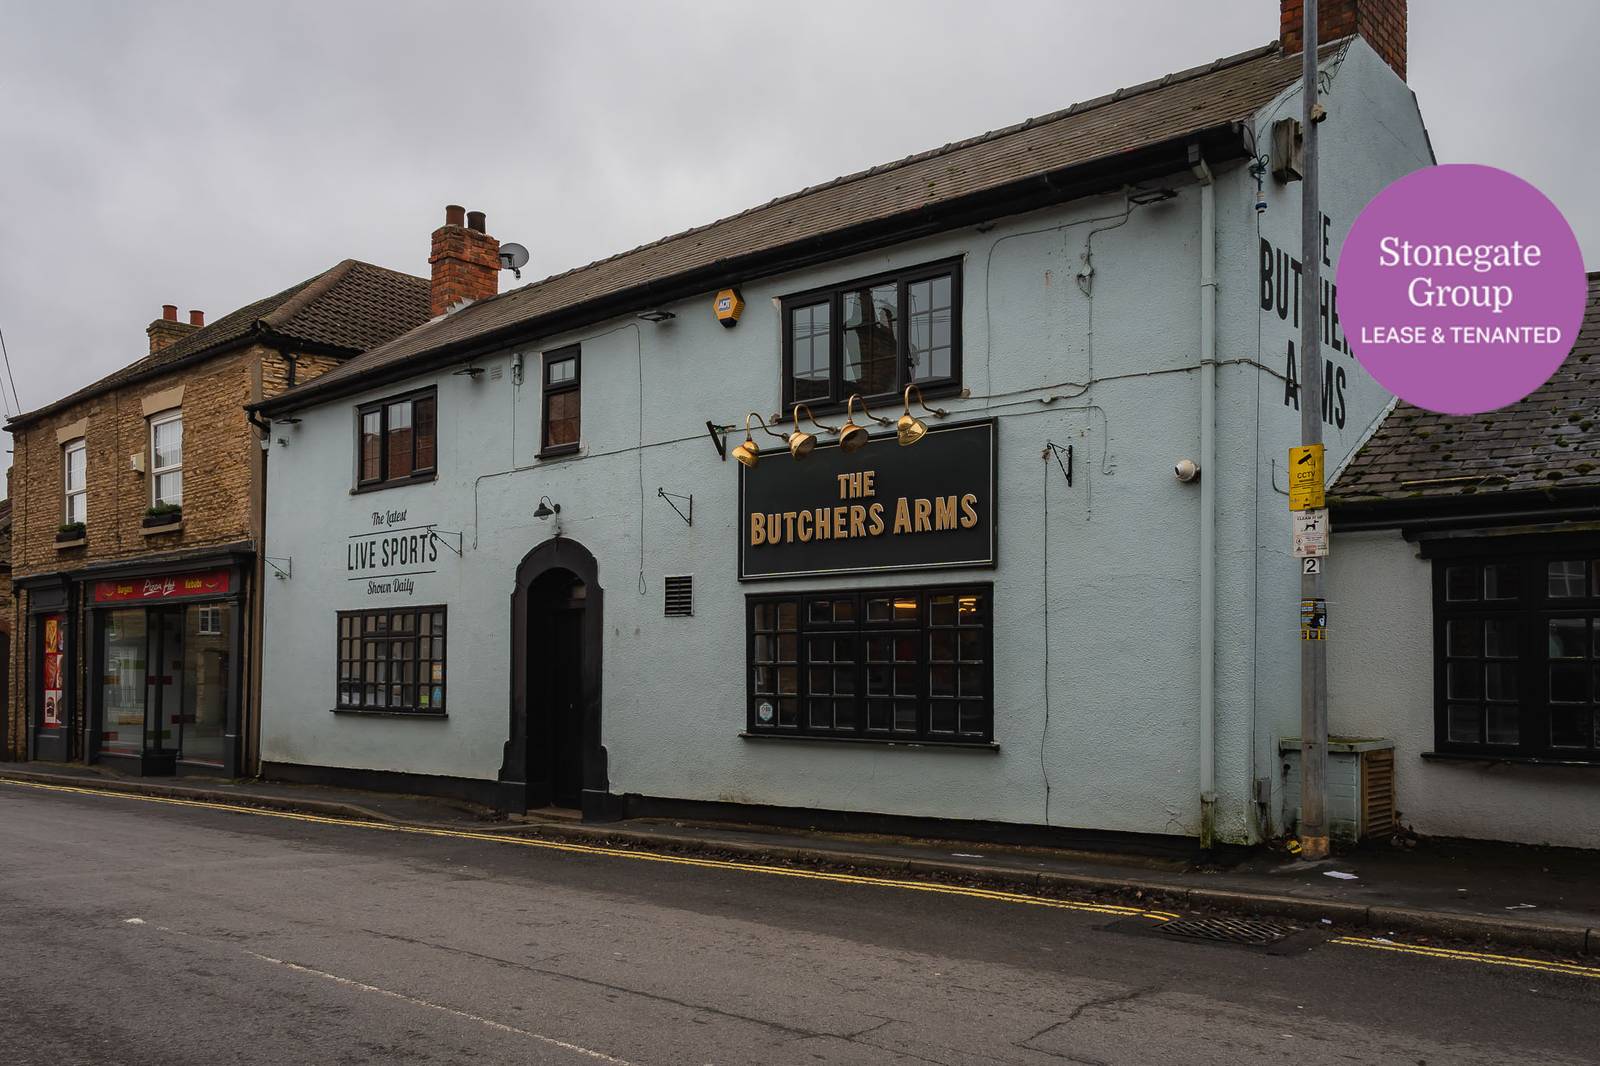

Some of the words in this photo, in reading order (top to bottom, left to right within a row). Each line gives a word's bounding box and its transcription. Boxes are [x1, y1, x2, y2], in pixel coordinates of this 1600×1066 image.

[1297, 471, 1315, 479] CCTV
[837, 470, 876, 499] THE
[371, 511, 385, 526] The
[385, 509, 407, 527] Latest
[751, 502, 885, 546] BUTCHERS
[893, 493, 978, 534] ARMS
[347, 541, 377, 571] LIVE
[382, 533, 438, 567] SPORTS
[1306, 559, 1316, 573] 2
[367, 580, 392, 595] Shown
[392, 578, 415, 596] Daily
